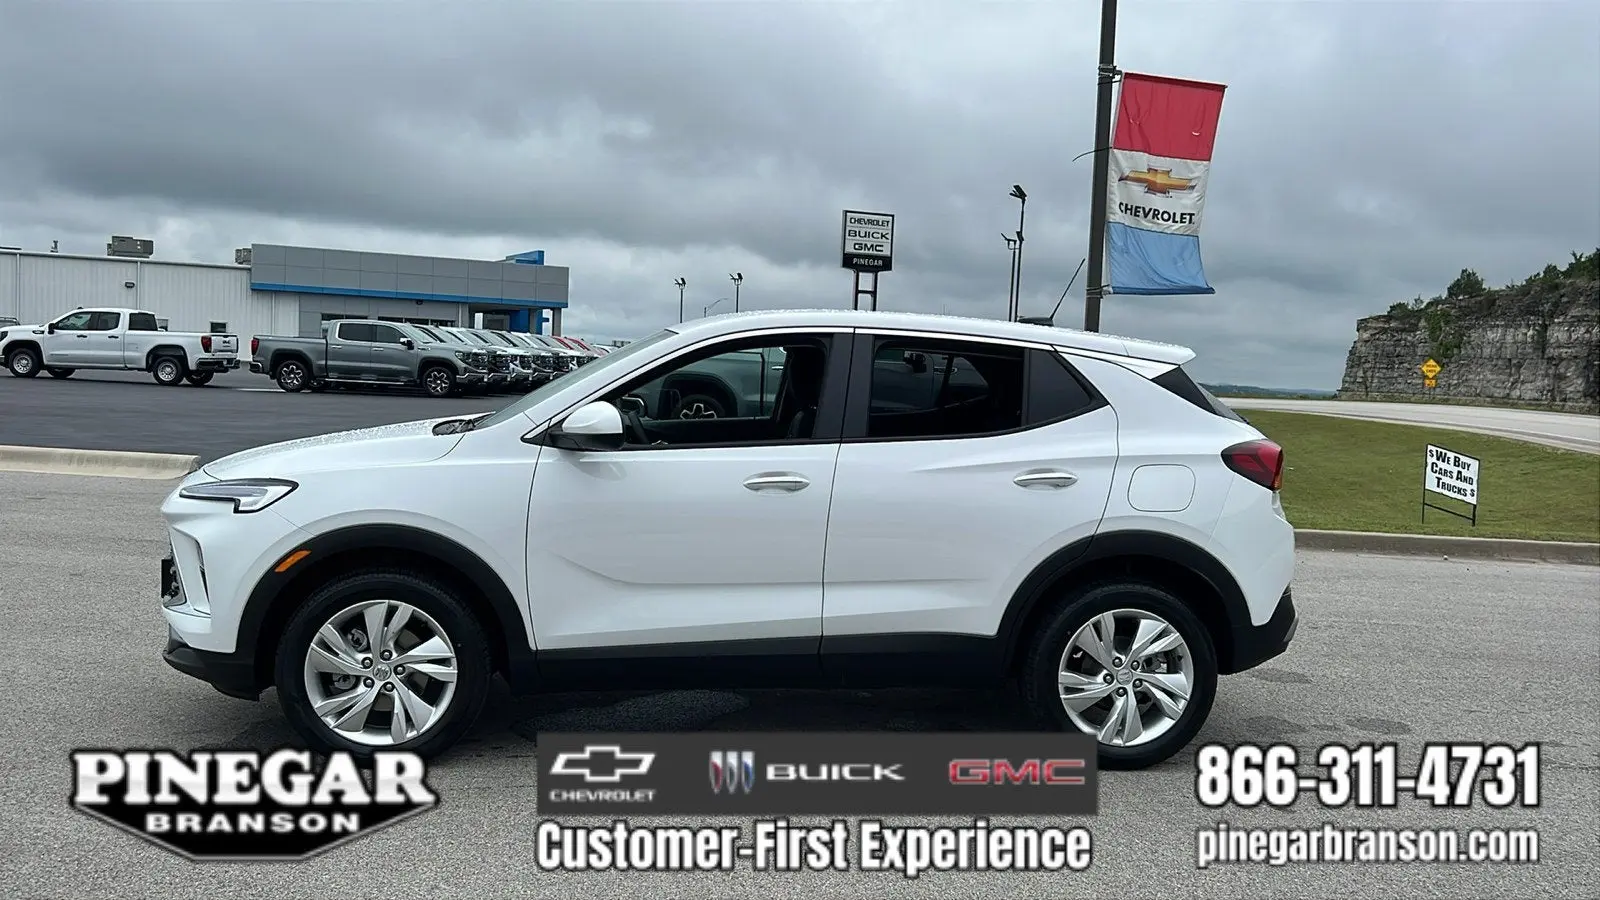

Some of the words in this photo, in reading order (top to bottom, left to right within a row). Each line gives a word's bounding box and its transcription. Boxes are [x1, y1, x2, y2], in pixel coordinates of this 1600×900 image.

[1118, 201, 1195, 225] CHEVROLET
[849, 217, 890, 227] CHEVROLET
[848, 230, 890, 240] BUICK
[853, 243, 884, 252] GMC
[852, 257, 883, 266] PINEGAR
[1453, 455, 1472, 471] BUY
[1430, 462, 1454, 480] CARS
[1455, 470, 1474, 486] AND
[1435, 476, 1468, 497] TRUCKS
